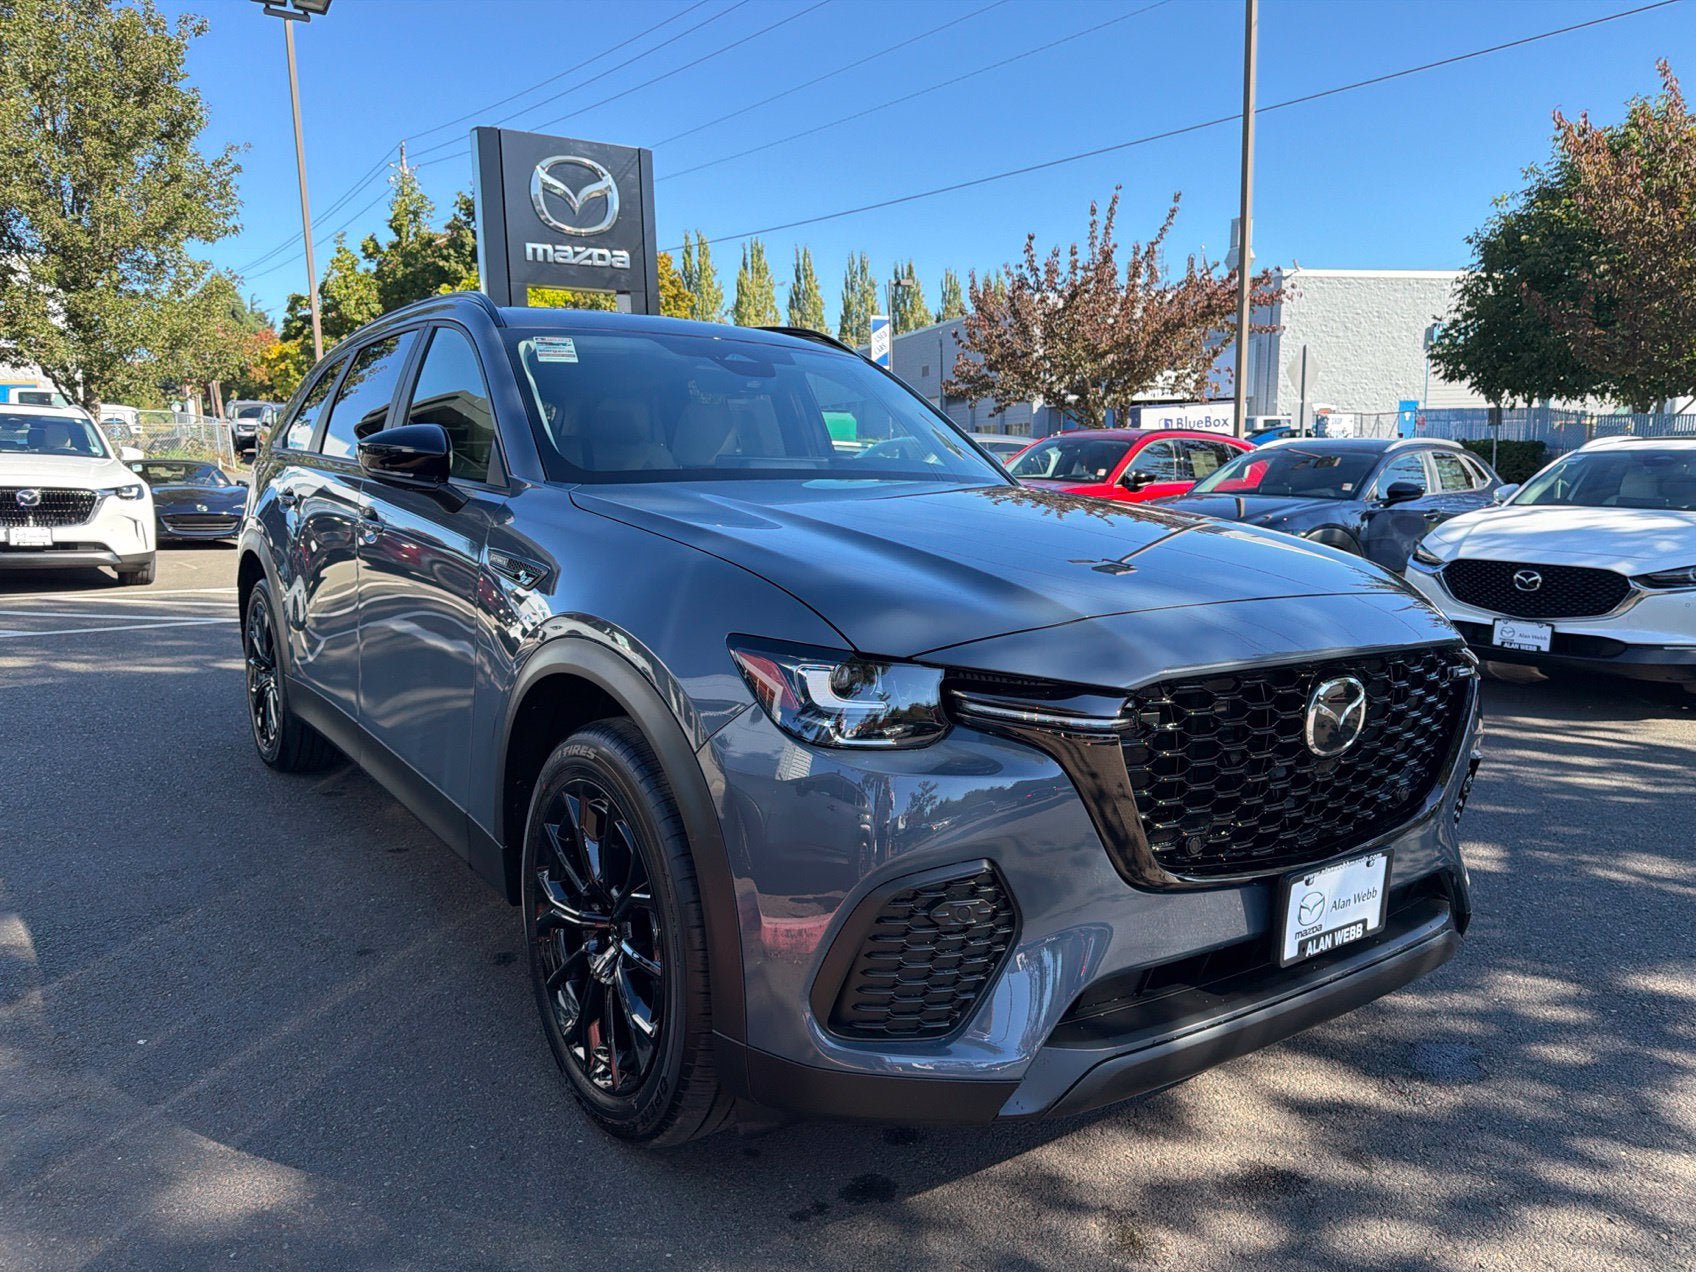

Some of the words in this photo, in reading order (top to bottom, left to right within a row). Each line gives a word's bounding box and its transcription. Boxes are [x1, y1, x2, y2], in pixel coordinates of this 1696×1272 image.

[525, 242, 631, 269] mazda
[1176, 415, 1230, 430] BlueBox
[1503, 642, 1520, 650] ALAN
[562, 744, 597, 760] TIRES
[1330, 898, 1351, 913] Alan
[1353, 886, 1378, 905] Webb
[1295, 923, 1323, 940] mazda
[1305, 933, 1333, 957] ALAN
[1334, 923, 1363, 946] WEBB
